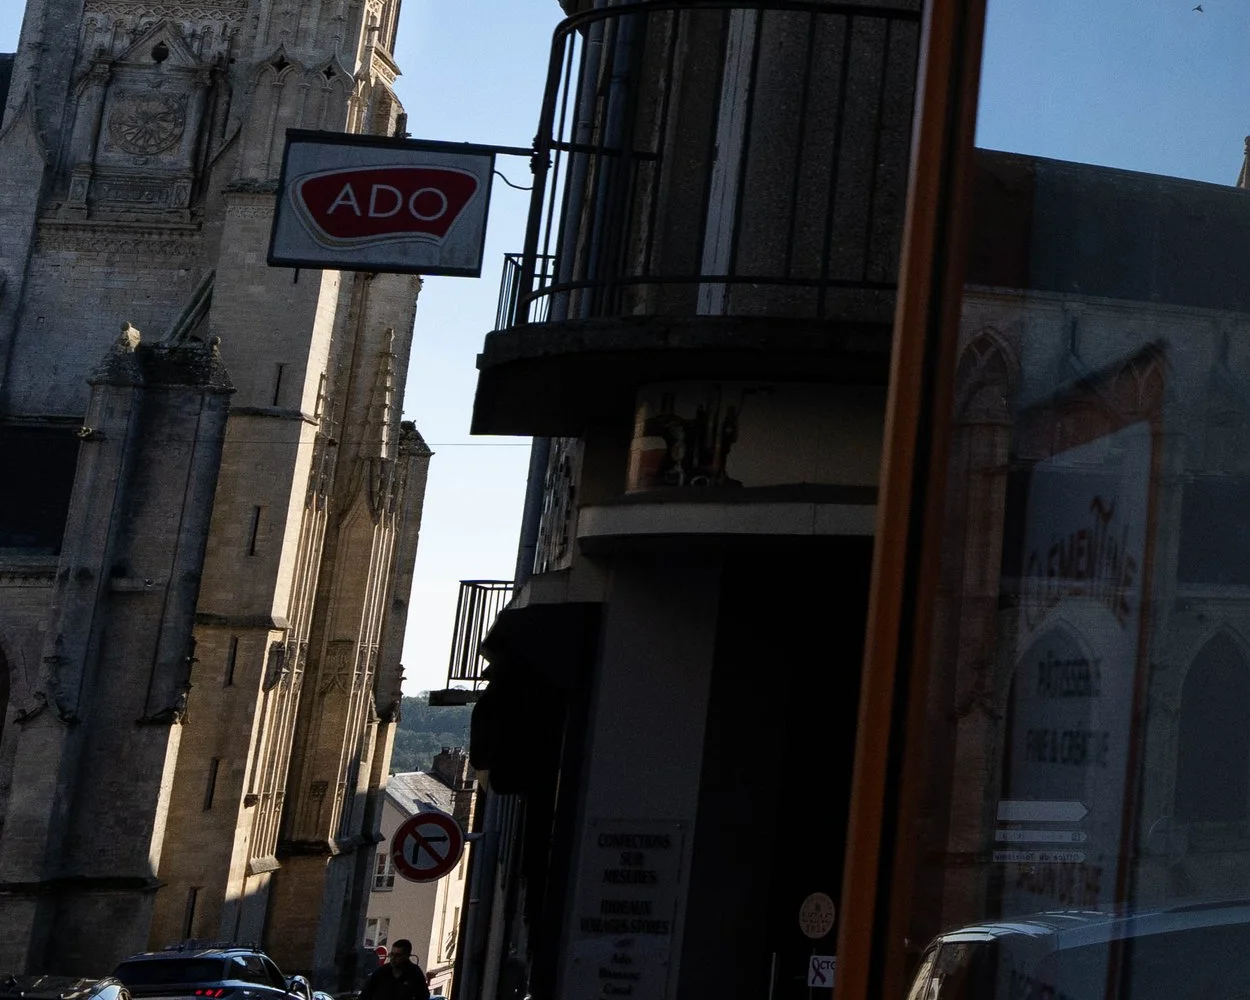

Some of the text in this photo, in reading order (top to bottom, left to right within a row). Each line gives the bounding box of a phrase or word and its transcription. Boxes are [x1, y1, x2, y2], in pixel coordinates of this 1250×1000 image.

[326, 181, 448, 222] ADO
[619, 851, 644, 867] SUR
[602, 868, 658, 885] MESURES
